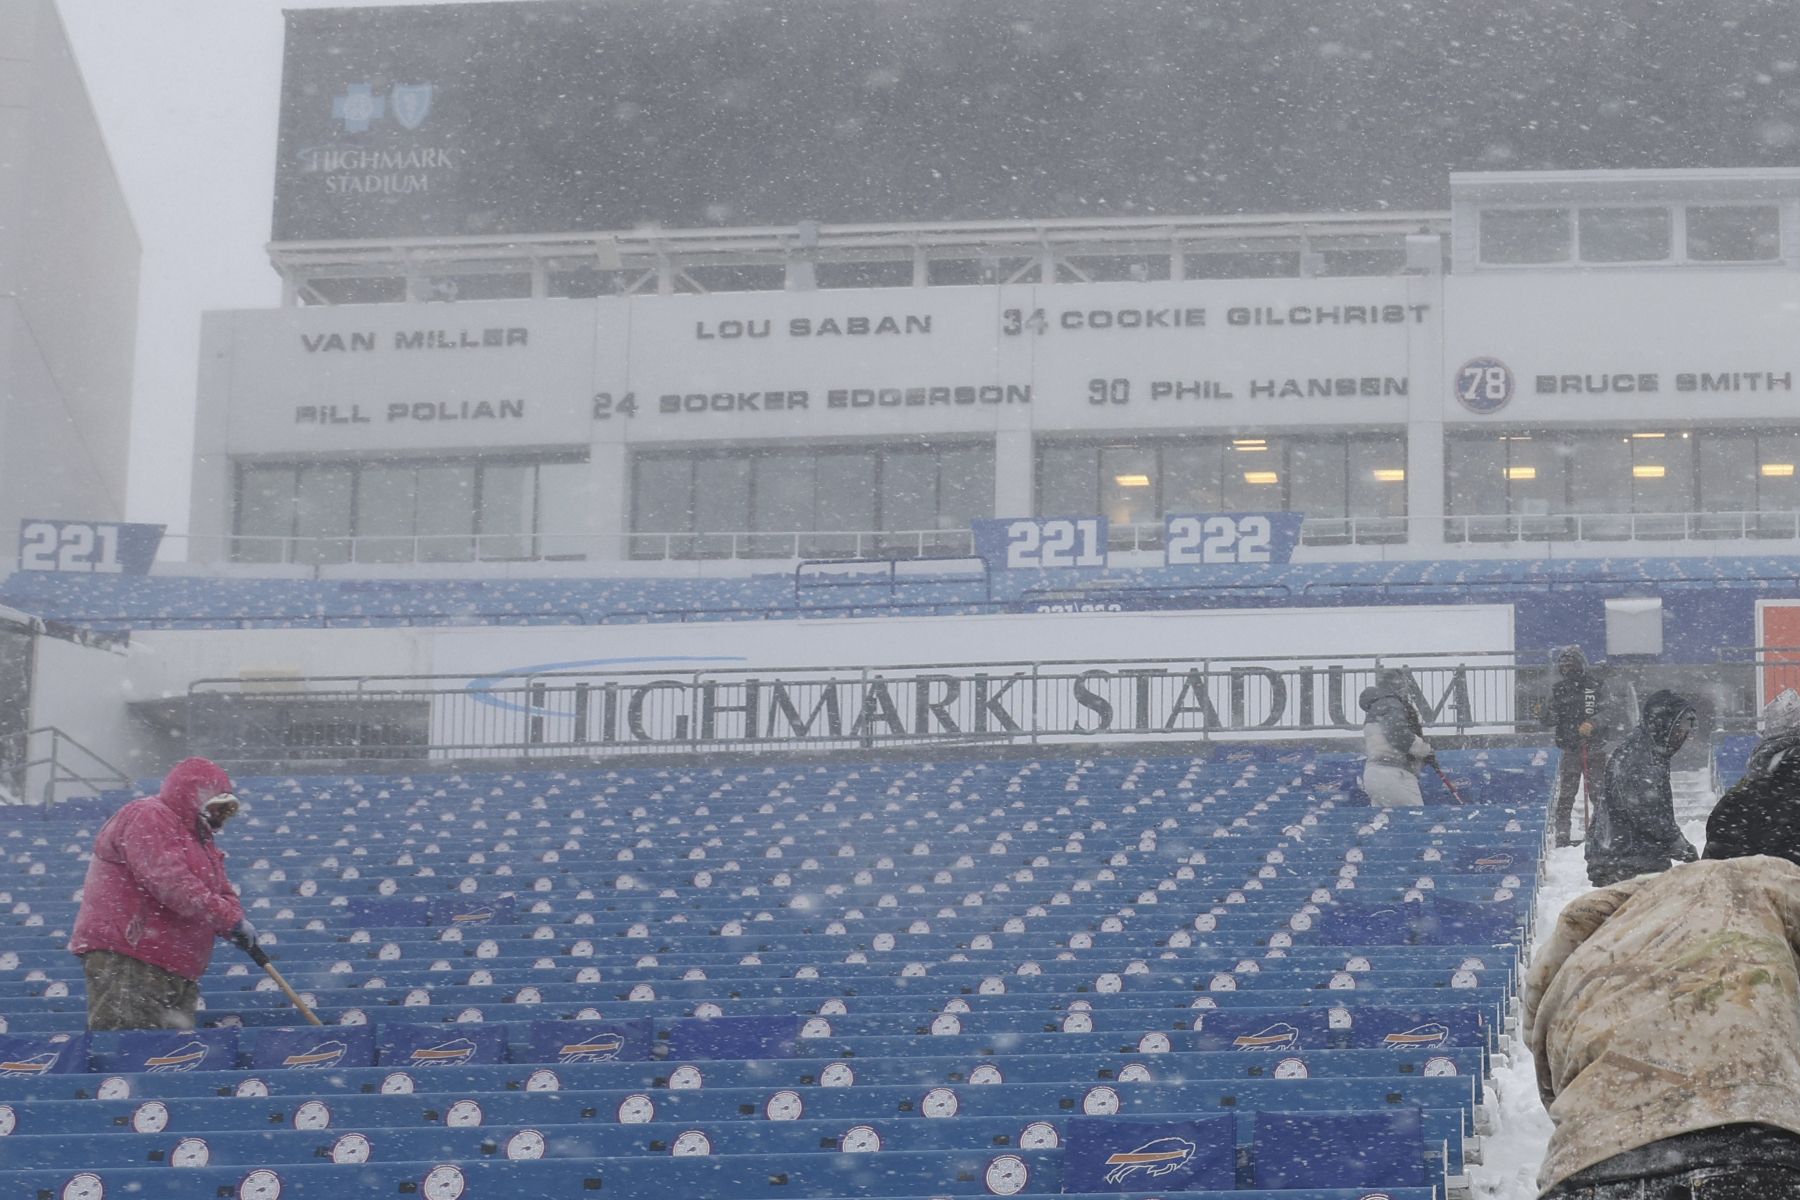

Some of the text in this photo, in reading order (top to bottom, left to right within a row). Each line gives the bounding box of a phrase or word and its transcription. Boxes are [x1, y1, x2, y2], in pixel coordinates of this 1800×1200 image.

[325, 174, 428, 194] STADIUM
[697, 314, 932, 341] LOU SABAN
[1003, 304, 1430, 335] 34 COOKIE GILCHRIST
[302, 326, 529, 353] VAN MILLER
[1088, 376, 1408, 405] 90 PHIL HANSEN
[1463, 367, 1792, 400] 78 BRUCE SMITH
[386, 399, 525, 422] POLIAN
[592, 393, 638, 420] 24
[659, 392, 810, 414] BOOKER
[22, 523, 123, 574] 221
[1006, 519, 1102, 568] 221
[1168, 516, 1271, 563] 222
[1072, 662, 1473, 735] STADIUM
